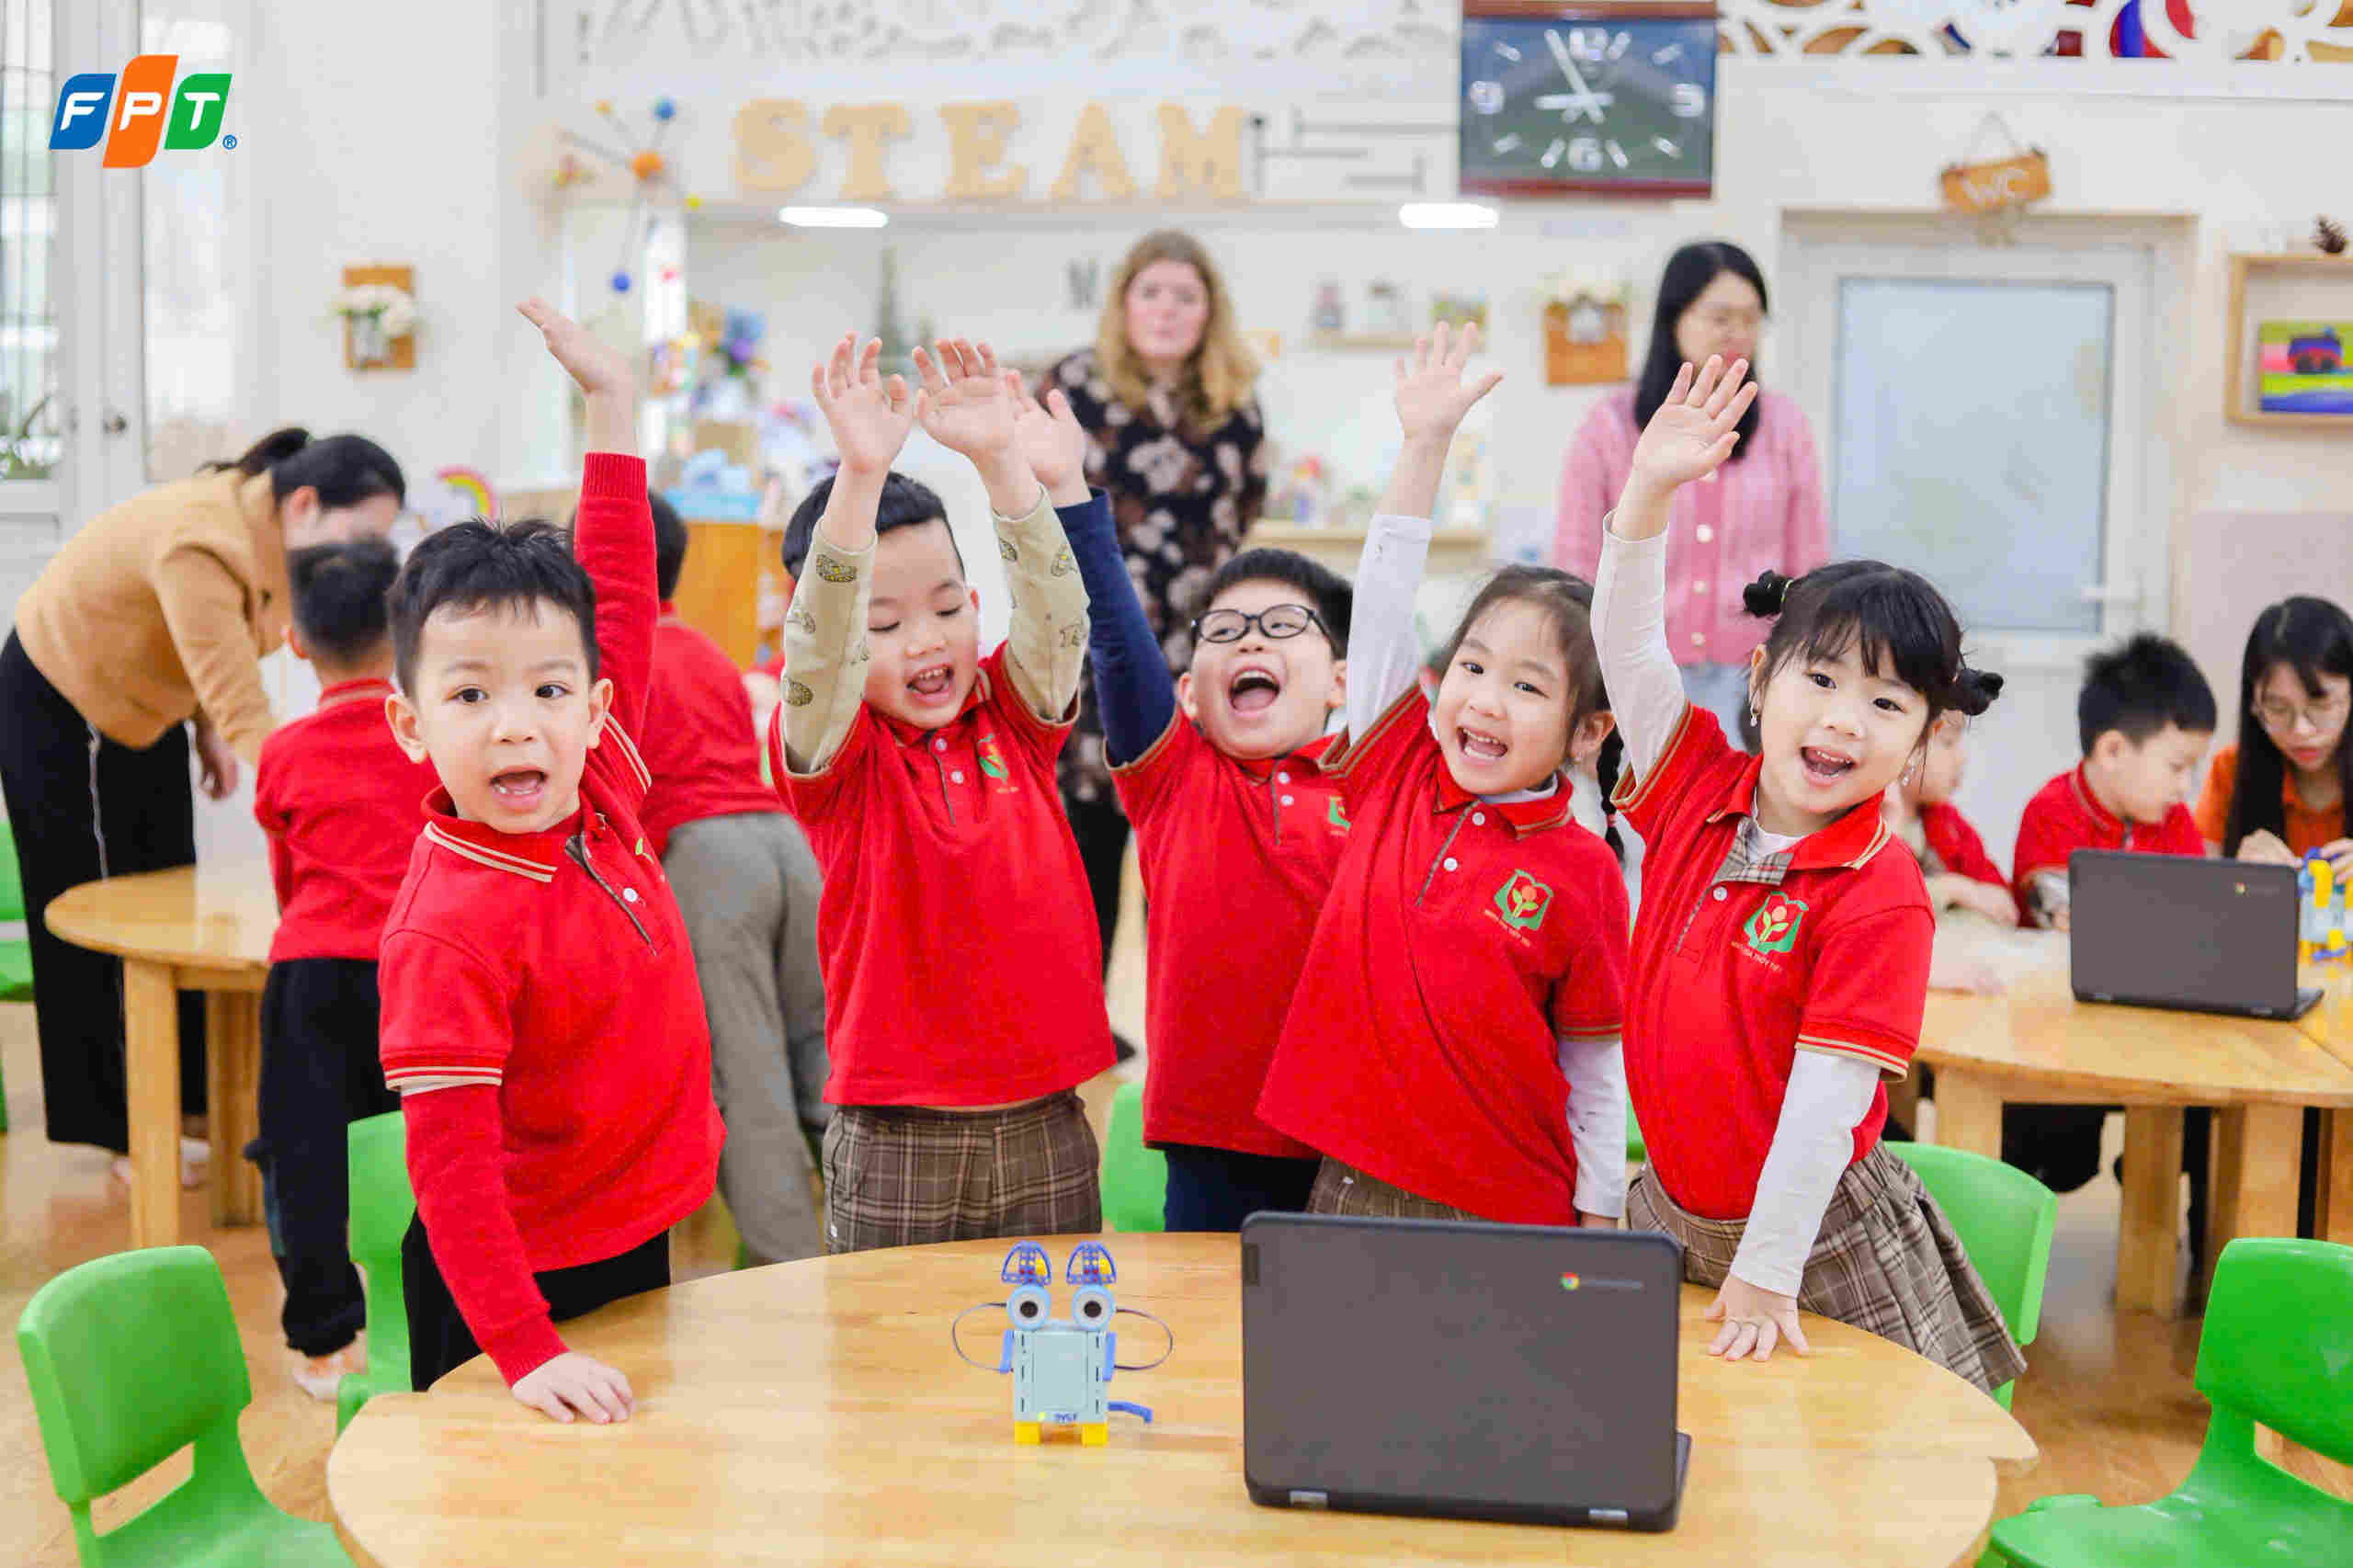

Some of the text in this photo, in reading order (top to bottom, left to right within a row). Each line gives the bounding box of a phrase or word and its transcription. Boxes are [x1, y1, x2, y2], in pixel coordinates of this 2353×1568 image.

[1669, 83, 1706, 118] 3
[733, 98, 1245, 199] STEAM
[1567, 137, 1603, 171] 6
